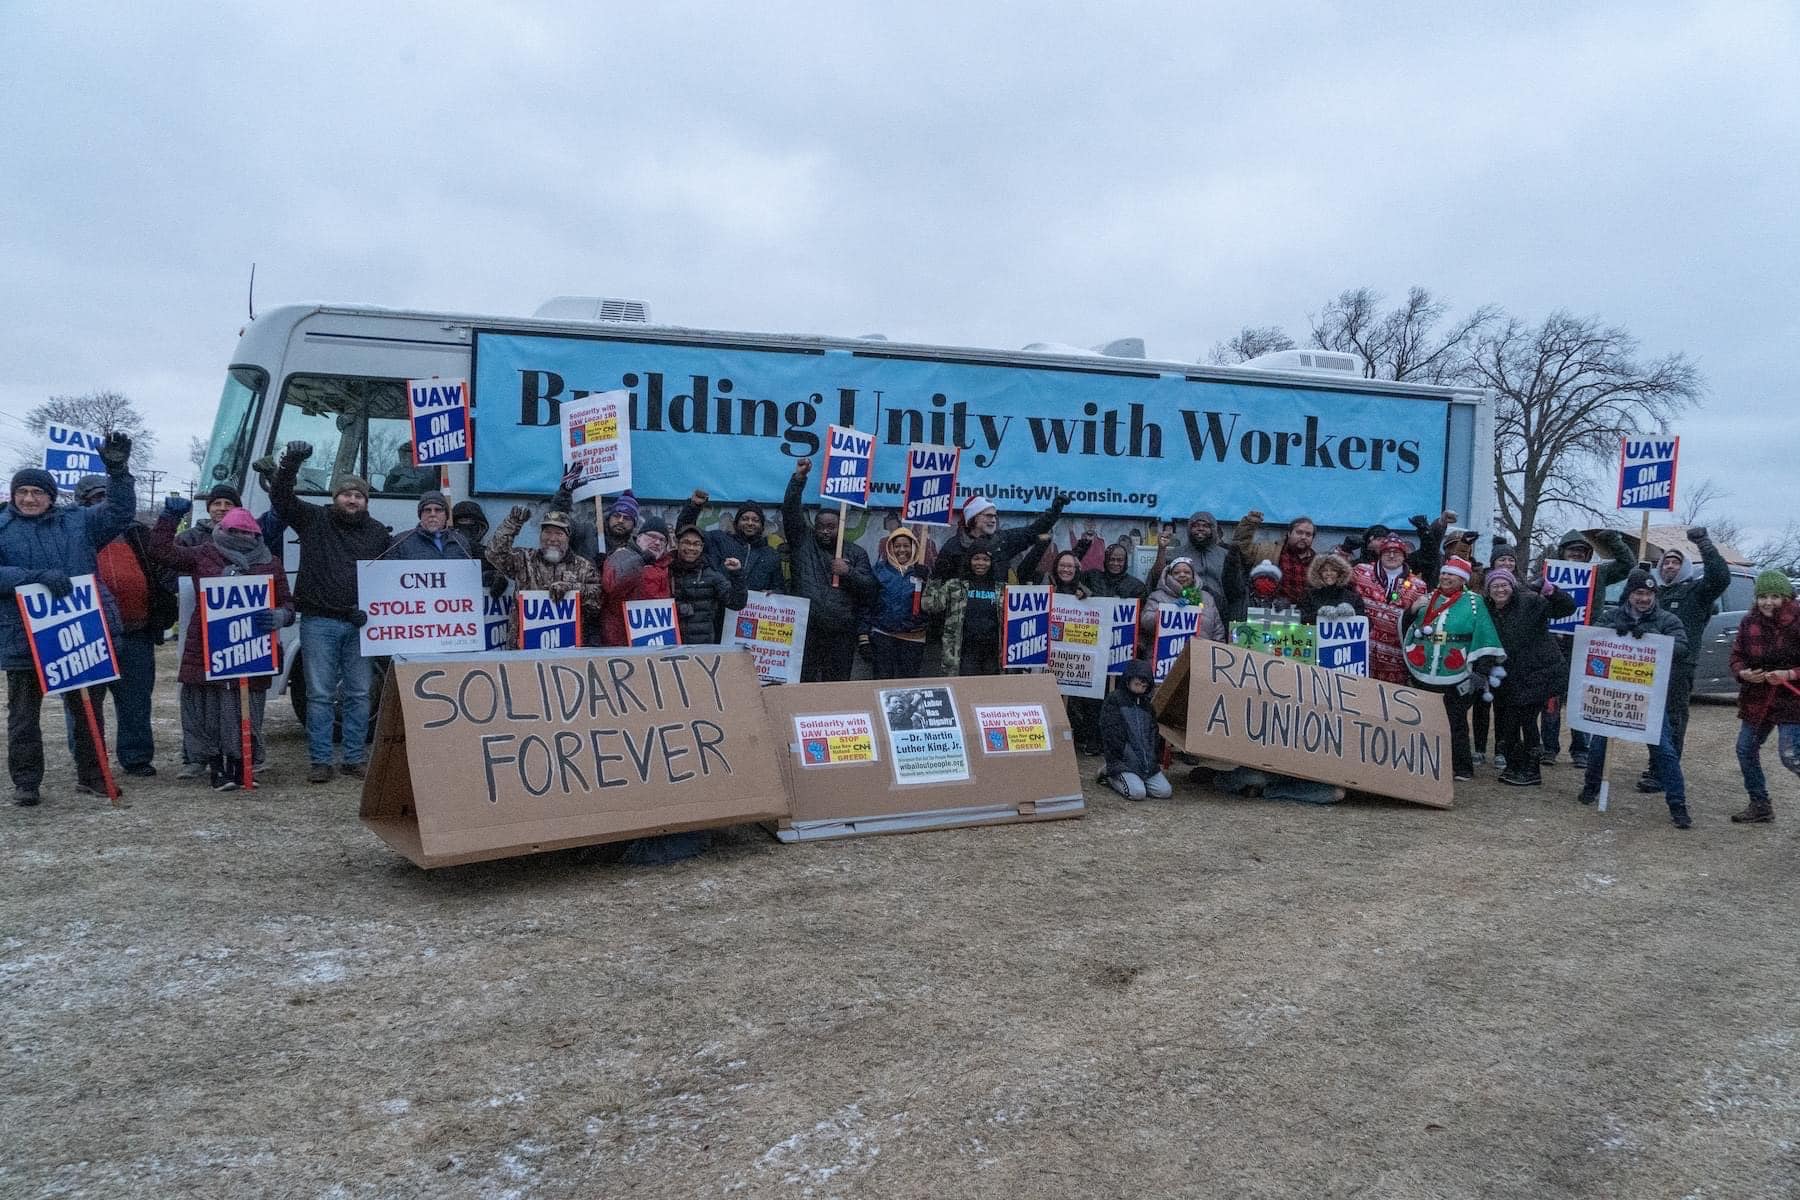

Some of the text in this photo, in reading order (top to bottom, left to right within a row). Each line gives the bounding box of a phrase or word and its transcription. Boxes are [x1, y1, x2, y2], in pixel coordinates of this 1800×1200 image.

[413, 386, 462, 408] UAW
[431, 413, 450, 436] ON
[517, 369, 1421, 474] Bilding Unity with Workers
[50, 426, 106, 450] UAW
[418, 429, 466, 461] STRIKE
[832, 432, 872, 457] UAW
[583, 444, 618, 457] Support
[591, 453, 616, 464] Local
[1626, 441, 1675, 459] UAW
[66, 453, 90, 469] ON
[840, 459, 857, 476] ON
[912, 450, 956, 472] UAW
[825, 476, 867, 494] STRIKE
[1638, 465, 1658, 485] ON
[922, 478, 939, 497] ON
[1622, 480, 1671, 506] STRIKE
[907, 494, 950, 518] STRIKE
[400, 572, 447, 589] CNH
[1546, 565, 1592, 586] UAW
[24, 584, 92, 619] UAW
[206, 584, 268, 610] UAW
[368, 598, 475, 616] STOLE OUR
[1008, 592, 1049, 612] UAW
[523, 598, 575, 620] UAW
[628, 607, 672, 629] UAW
[758, 612, 779, 620] Local
[1051, 607, 1100, 617] olidarity with
[228, 616, 252, 643] ON
[1021, 618, 1037, 639] ON
[1161, 610, 1198, 631] UAW
[57, 620, 85, 652] ON
[366, 622, 478, 641] CHRISTMAS
[490, 625, 507, 646] ON
[540, 629, 560, 649] ON
[1320, 622, 1365, 640] UAW
[211, 634, 272, 673] STRIKE
[751, 645, 790, 656] Support
[1008, 633, 1048, 663] STRIKE
[1109, 644, 1134, 665] RIKE
[1169, 635, 1186, 656] ON
[1274, 647, 1312, 657] SCAB
[1588, 648, 1656, 663] UAW Local 180
[1589, 639, 1657, 655] Solidarity with
[45, 638, 110, 687] STRIKE
[758, 656, 786, 667] Local
[1050, 659, 1065, 668] One
[1066, 661, 1073, 669] is
[1058, 651, 1081, 661] Injury
[1082, 653, 1091, 661] to
[1333, 646, 1352, 666] ON
[1066, 669, 1075, 678] to
[1077, 670, 1090, 679] All!
[413, 653, 723, 729] SOLIDARITY
[1210, 645, 1422, 727] RACINE IS
[1588, 684, 1644, 701] An Injury to
[1583, 702, 1644, 721] Injury to All!
[1591, 695, 1638, 711] One is an
[800, 717, 866, 729] Solidarity with
[980, 711, 1020, 719] Solidarity
[825, 728, 850, 737] Local
[852, 727, 868, 735] 180
[924, 731, 953, 741] Martin
[1206, 694, 1442, 782] A UNION TOWN
[896, 744, 925, 754] Luther
[952, 741, 962, 750] Jr.
[480, 719, 733, 803] FOREVER
